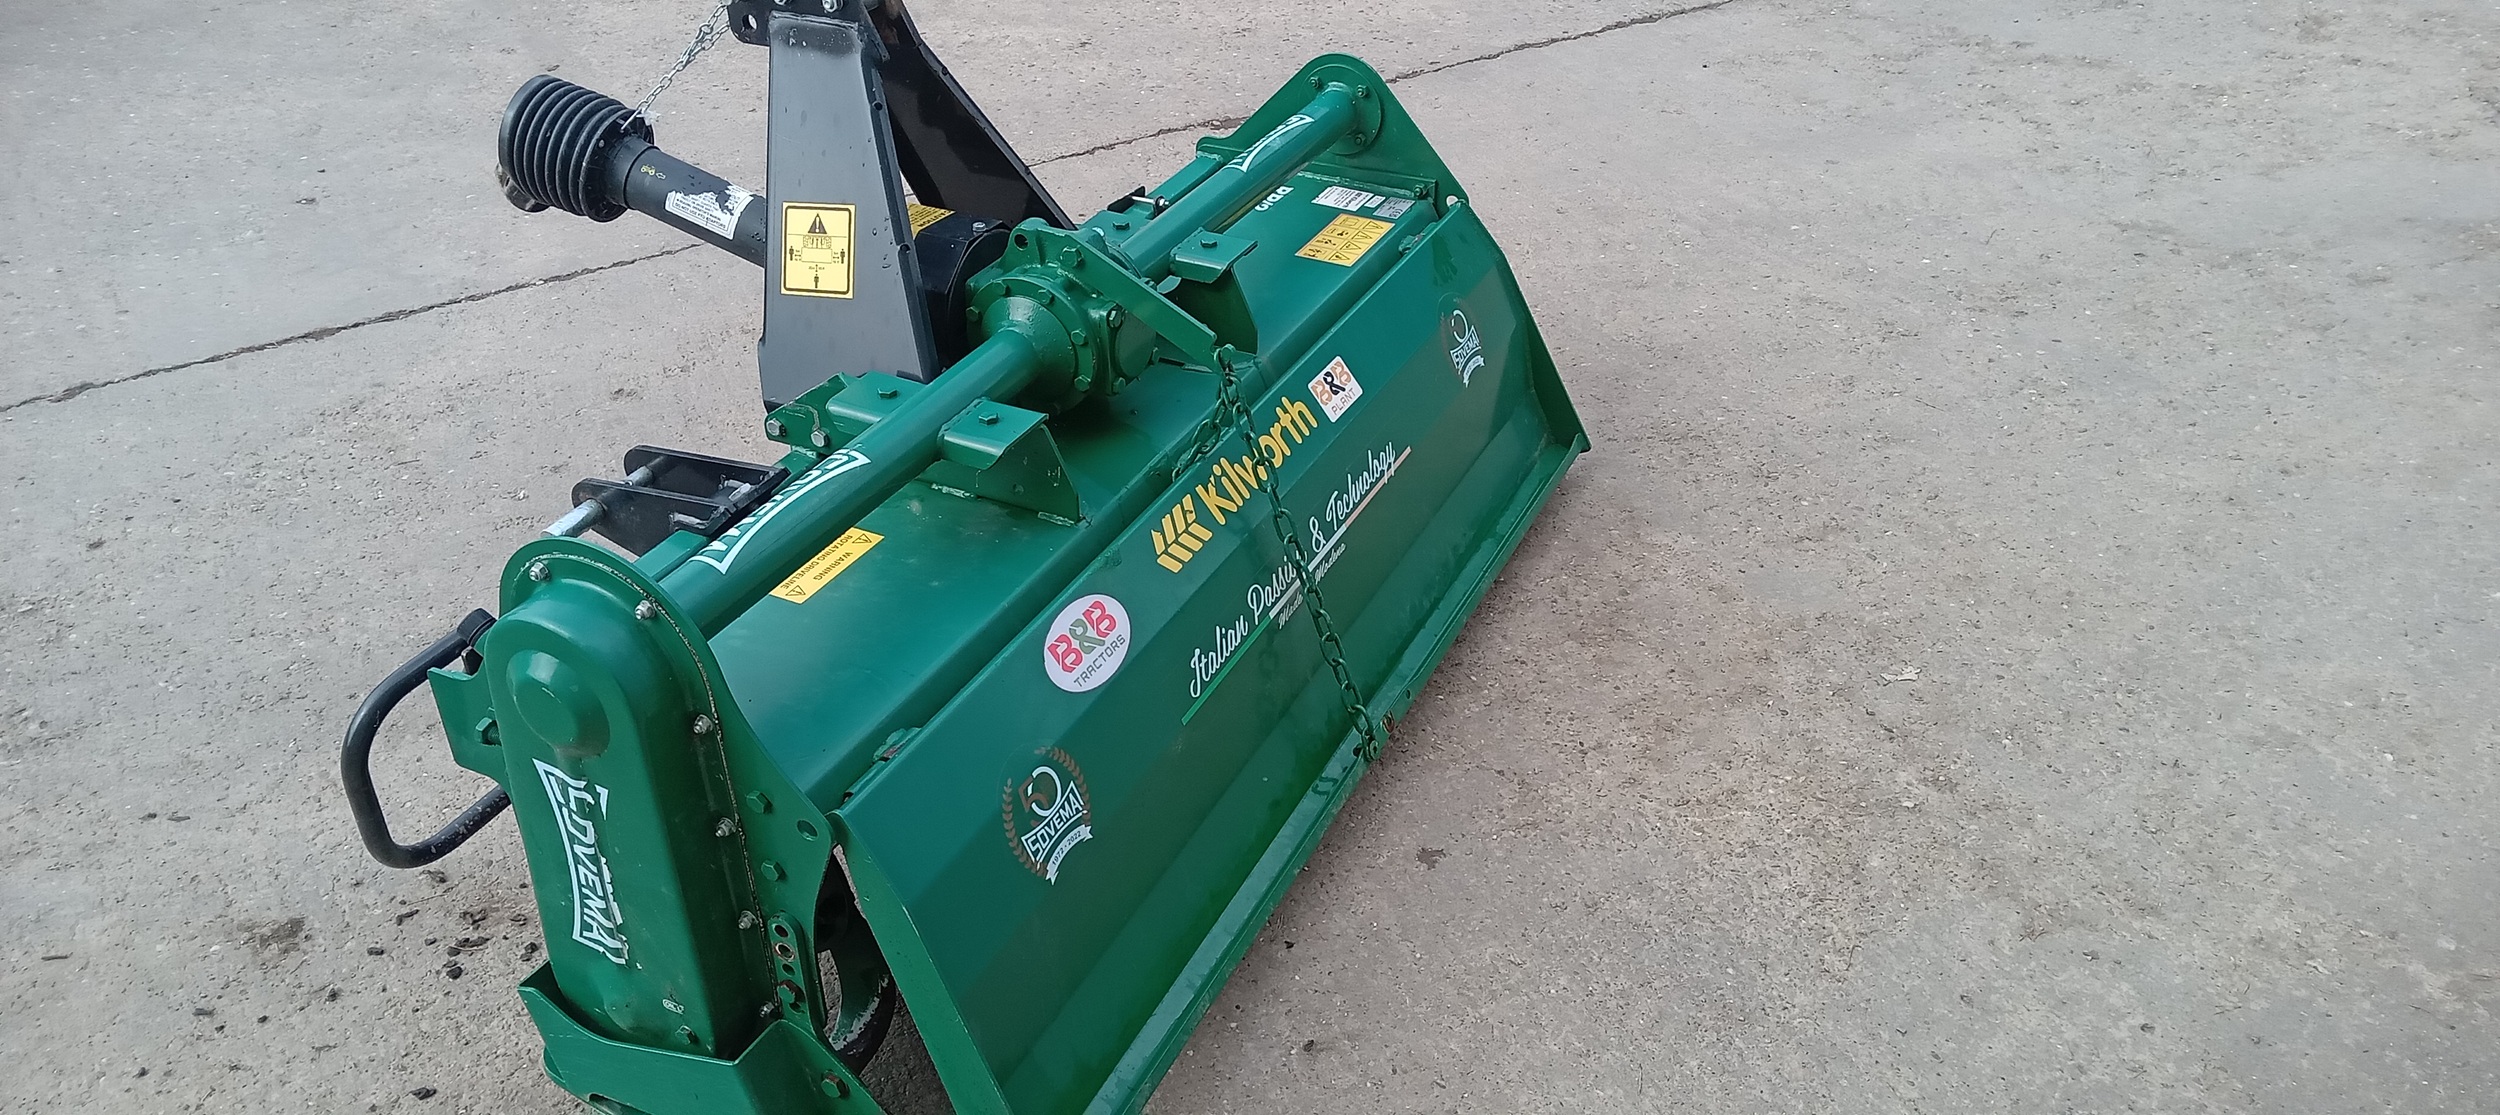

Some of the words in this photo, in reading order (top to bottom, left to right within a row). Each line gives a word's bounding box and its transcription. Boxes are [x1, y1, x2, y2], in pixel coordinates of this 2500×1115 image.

[1453, 331, 1480, 368] SOVEMA
[1311, 361, 1352, 406] B&B
[1331, 387, 1356, 416] PLANT
[1195, 396, 1319, 525] Kilworth
[812, 551, 853, 581] WARNING
[816, 534, 853, 561] ROTATING
[780, 560, 820, 590] DRIVELINE
[1189, 614, 1249, 698] Italian
[1247, 550, 1308, 626] Passi
[1309, 516, 1326, 552] &
[1326, 441, 1396, 531] Technology
[1047, 600, 1117, 674] B&B
[1073, 634, 1126, 688] TRACTORS
[1027, 792, 1083, 862] SOVEMA
[1051, 847, 1064, 866] 1972
[1066, 830, 1082, 846] 2022
